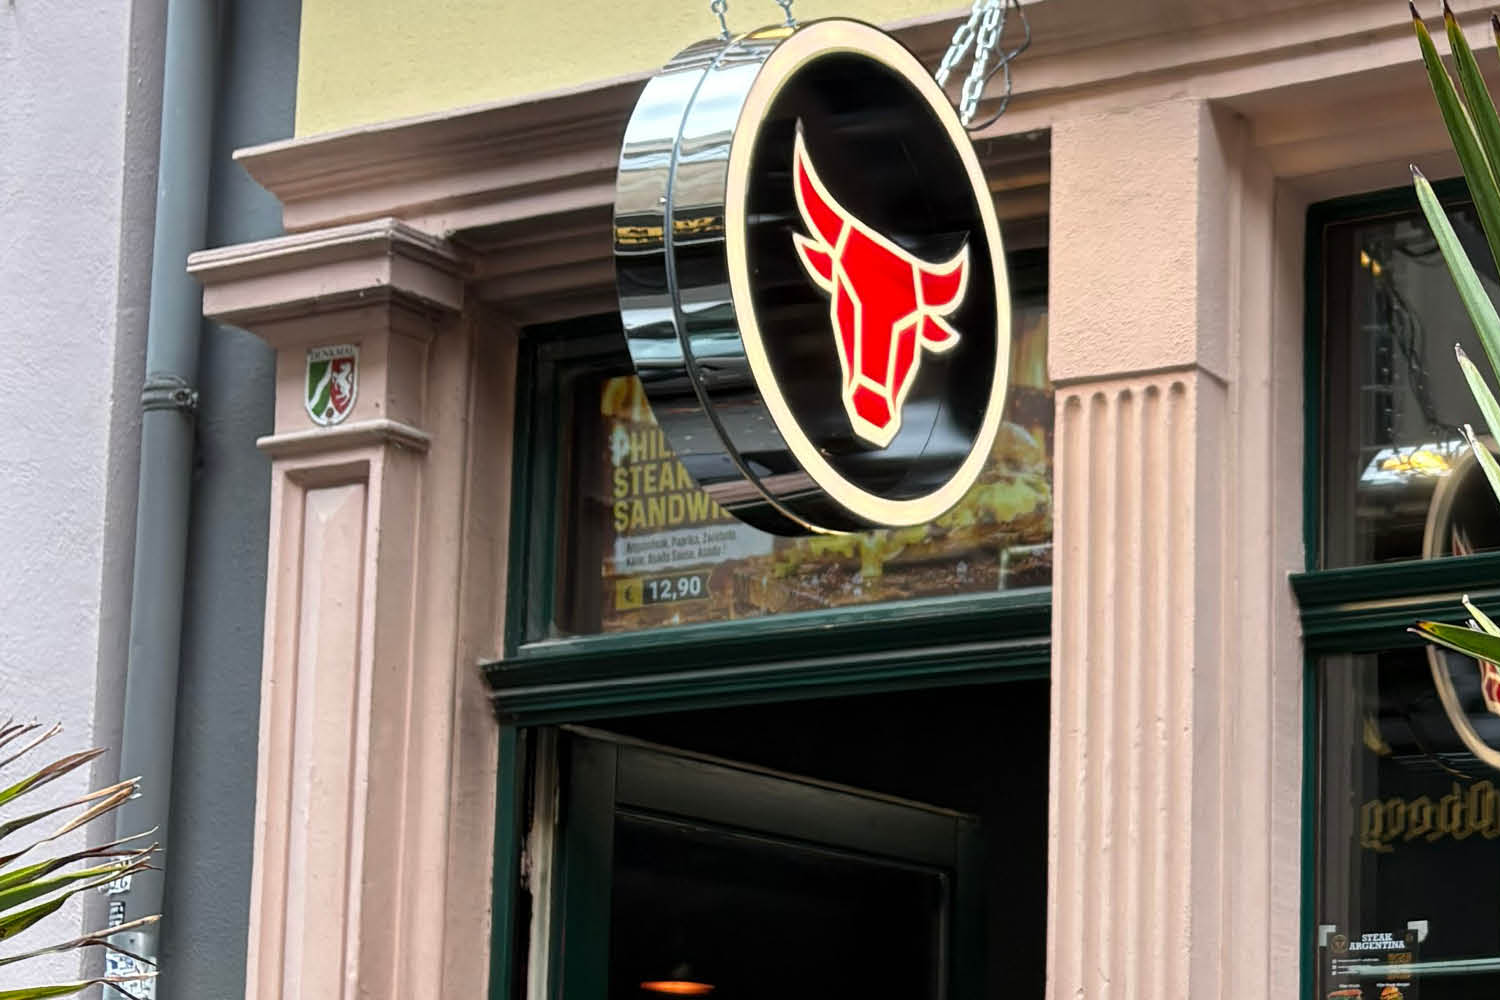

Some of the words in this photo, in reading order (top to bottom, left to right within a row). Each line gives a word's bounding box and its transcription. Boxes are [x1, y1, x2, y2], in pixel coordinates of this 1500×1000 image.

[650, 575, 702, 602] 12,90
[1361, 932, 1393, 942] STEAK
[1348, 940, 1406, 951] ARGENTINA
